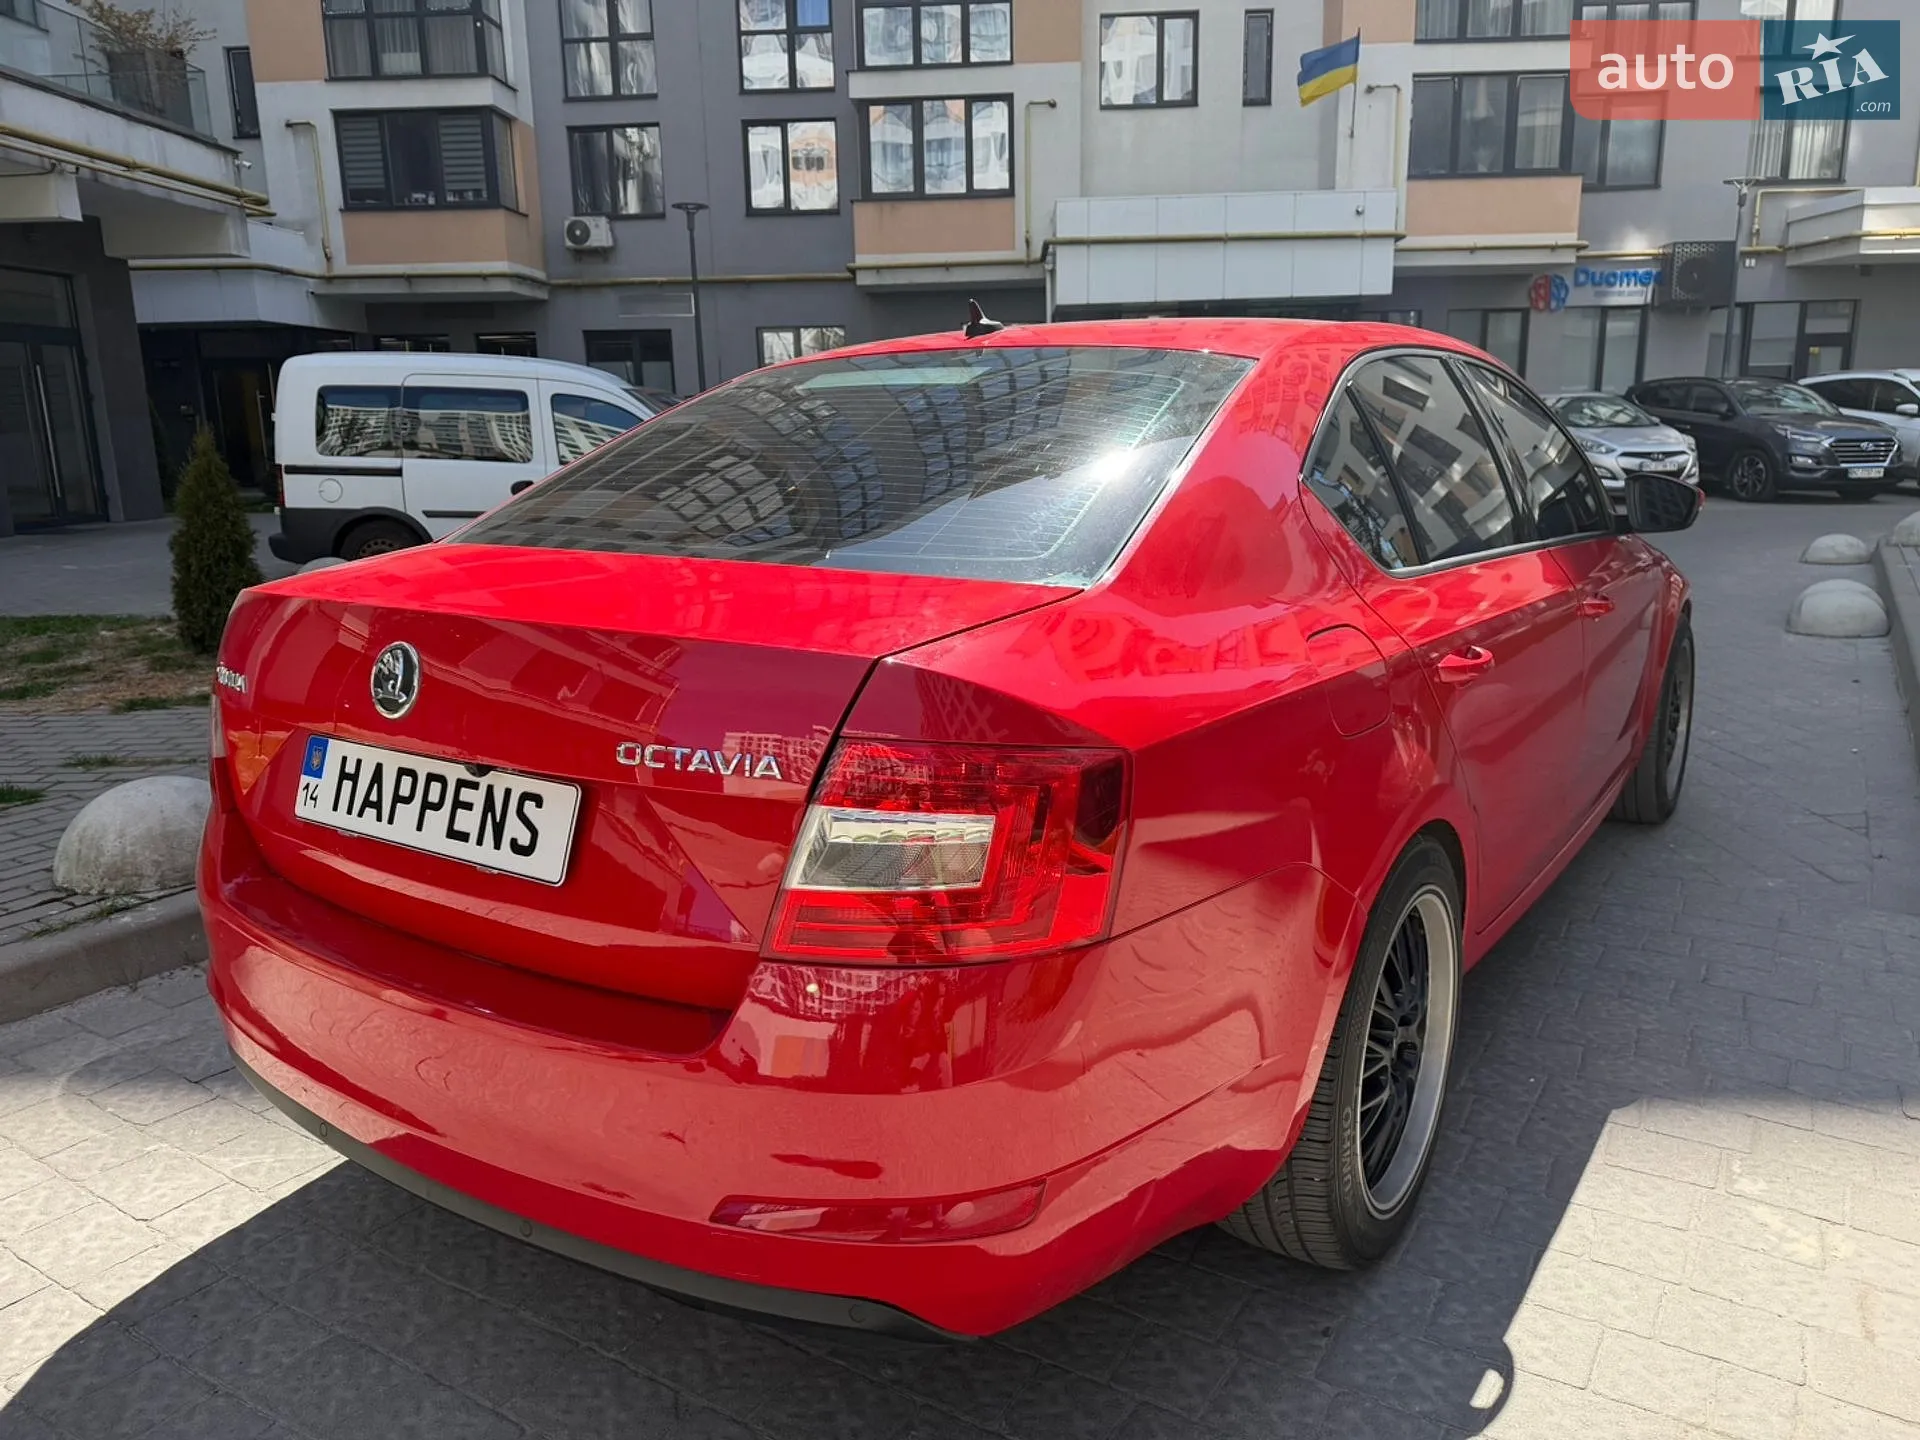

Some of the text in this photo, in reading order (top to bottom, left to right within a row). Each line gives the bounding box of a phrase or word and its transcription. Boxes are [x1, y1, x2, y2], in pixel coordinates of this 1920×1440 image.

[616, 741, 783, 780] OCTAVIA
[302, 782, 319, 809] 14
[332, 755, 544, 857] HAPPENS
